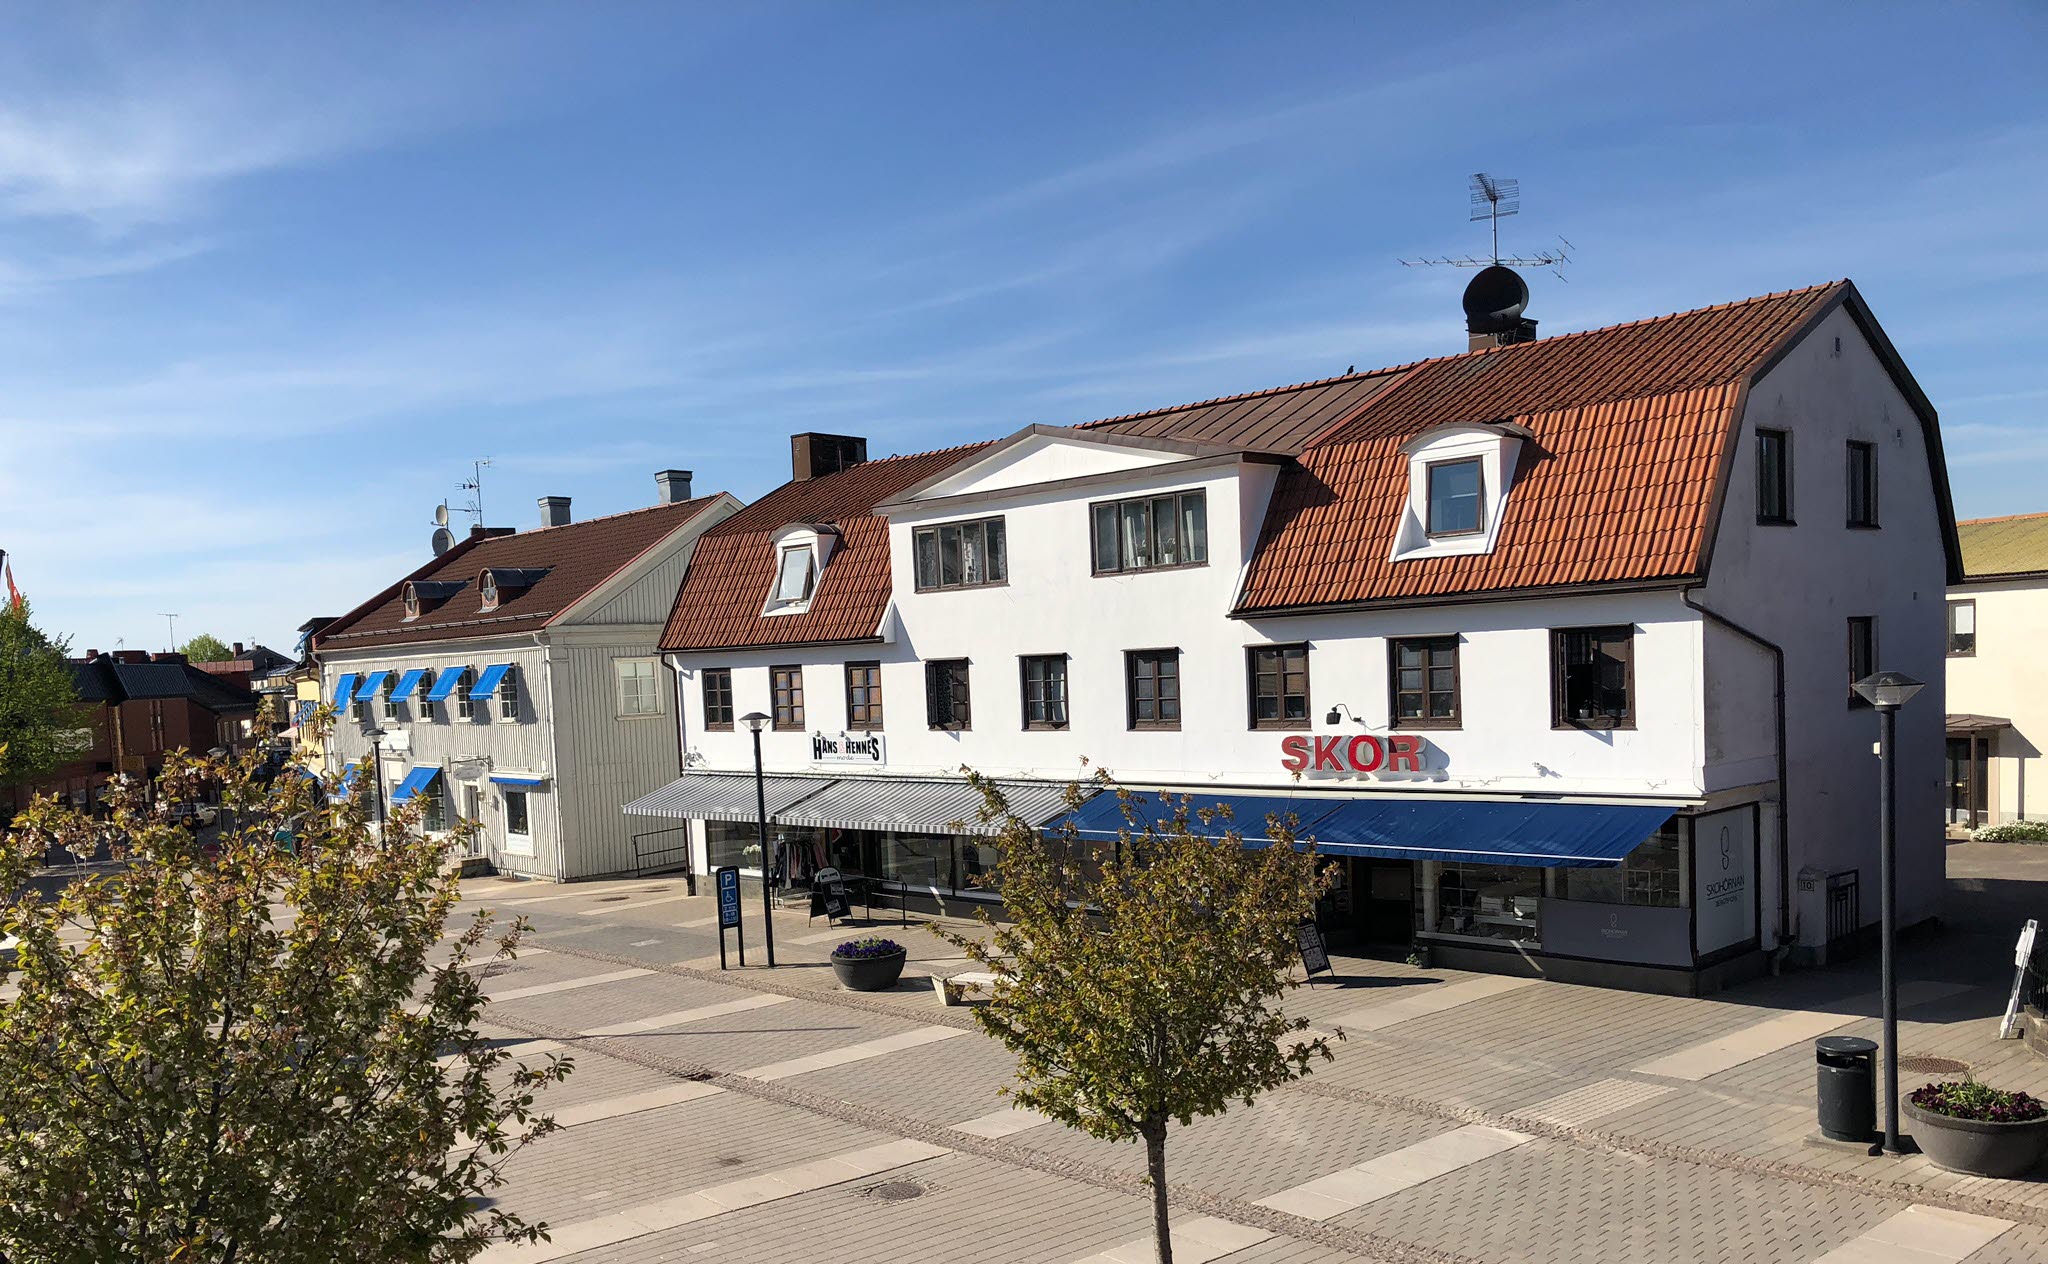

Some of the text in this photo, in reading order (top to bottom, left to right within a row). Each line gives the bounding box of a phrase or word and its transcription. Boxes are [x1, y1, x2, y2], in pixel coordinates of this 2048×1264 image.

[813, 737, 880, 761] HANS & HENNES
[1281, 734, 1421, 772] SKOR
[725, 874, 732, 886] P
[1803, 881, 1812, 890] 10
